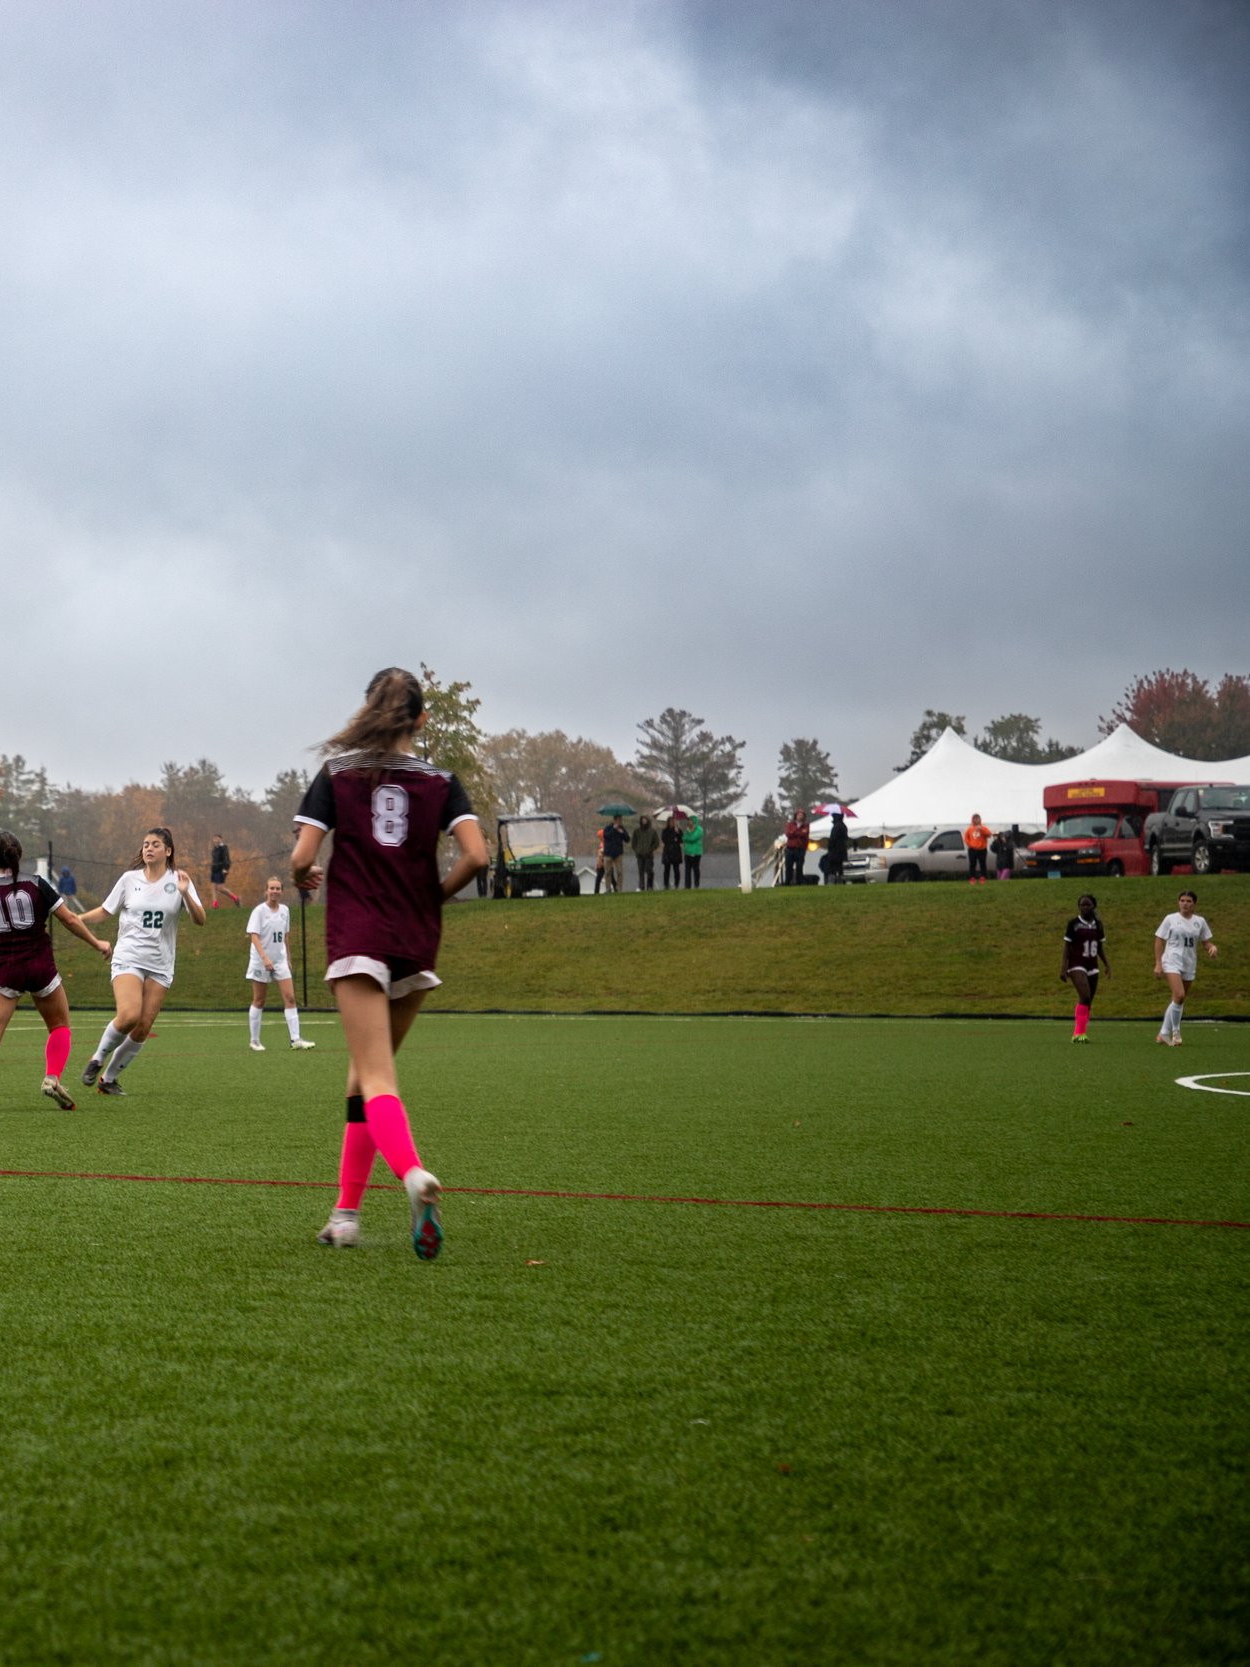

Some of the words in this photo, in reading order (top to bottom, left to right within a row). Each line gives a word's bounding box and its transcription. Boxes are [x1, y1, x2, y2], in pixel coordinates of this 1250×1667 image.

[371, 784, 409, 847] 8
[143, 910, 164, 929] 22
[273, 931, 283, 943] 16
[1082, 940, 1098, 958] 16
